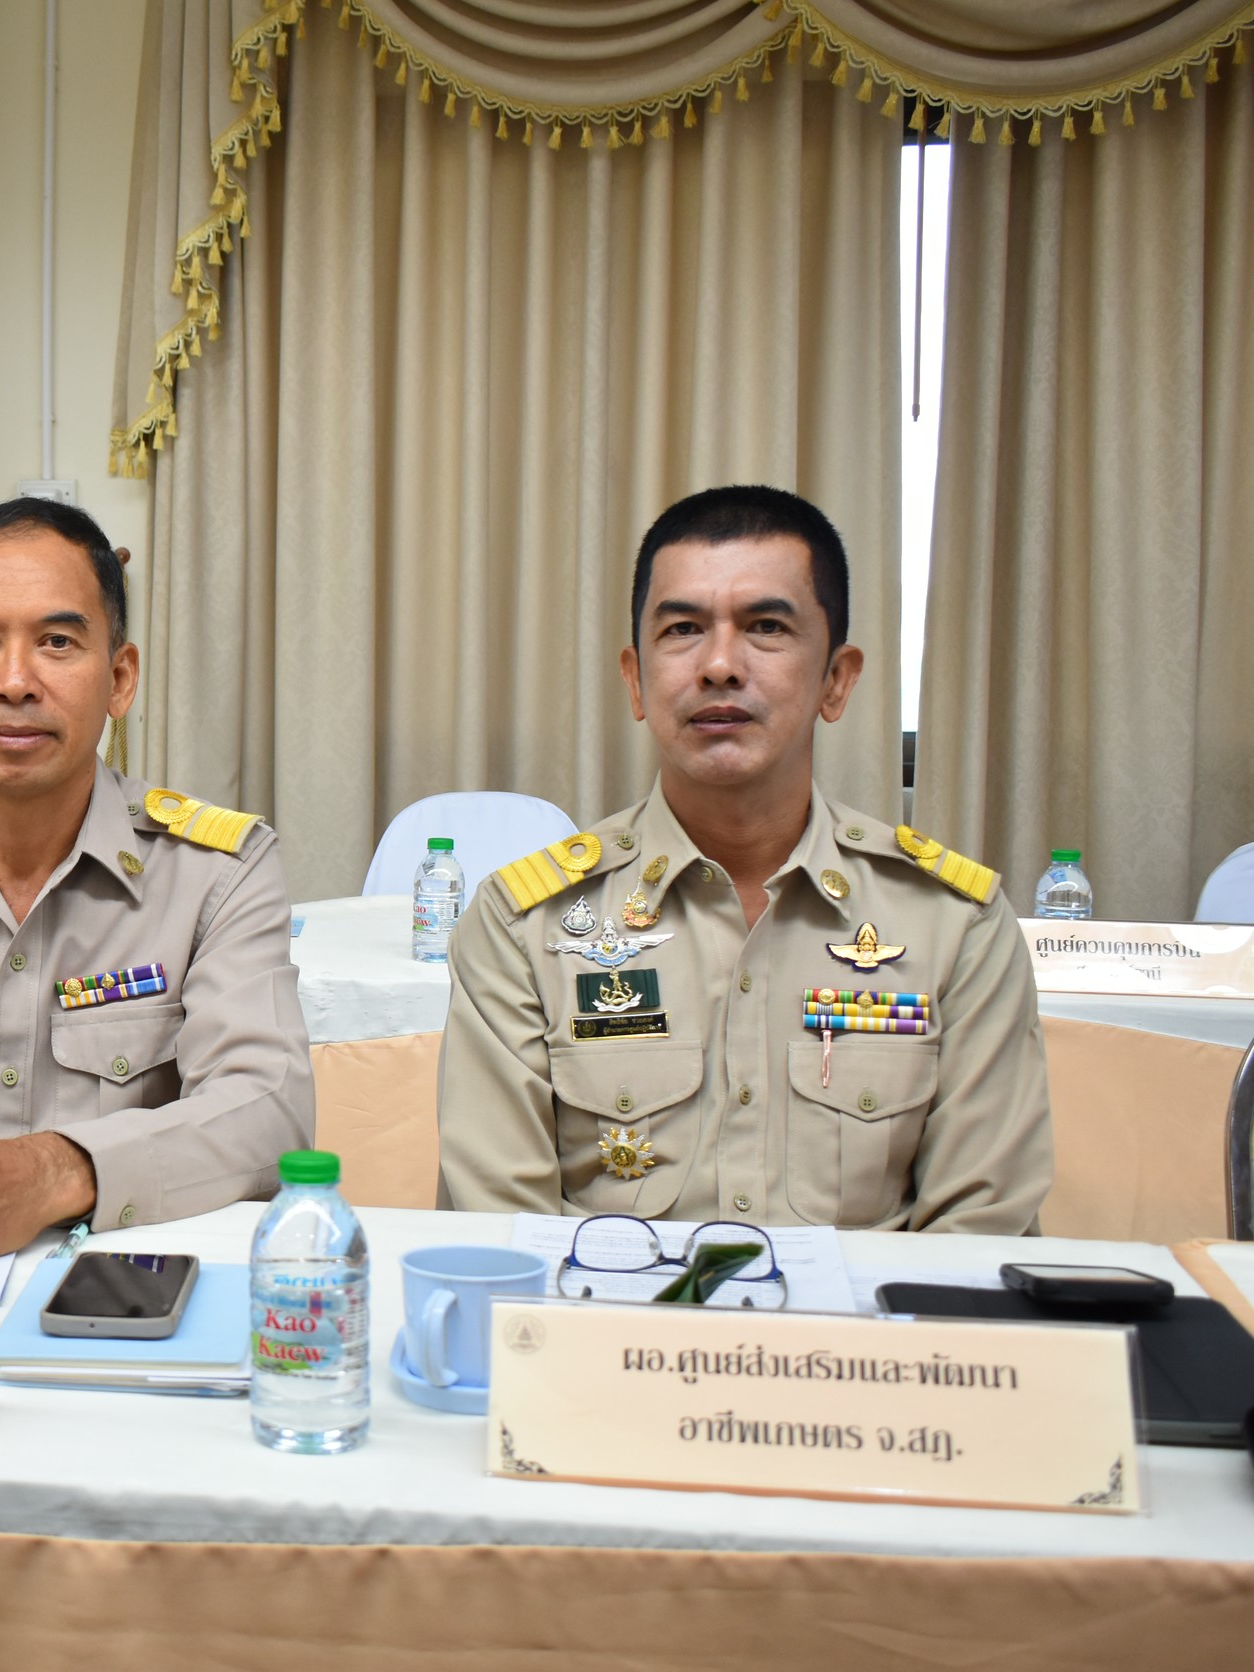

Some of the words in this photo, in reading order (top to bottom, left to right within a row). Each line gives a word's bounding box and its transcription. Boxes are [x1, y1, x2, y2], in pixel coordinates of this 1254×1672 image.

[265, 1308, 317, 1334] Kao
[258, 1336, 325, 1363] Kaew
[622, 1344, 1018, 1389] ผอ.ศูนย์ส่งเสริมและพัฒนา
[678, 1410, 863, 1450] อาชีพเกษตร
